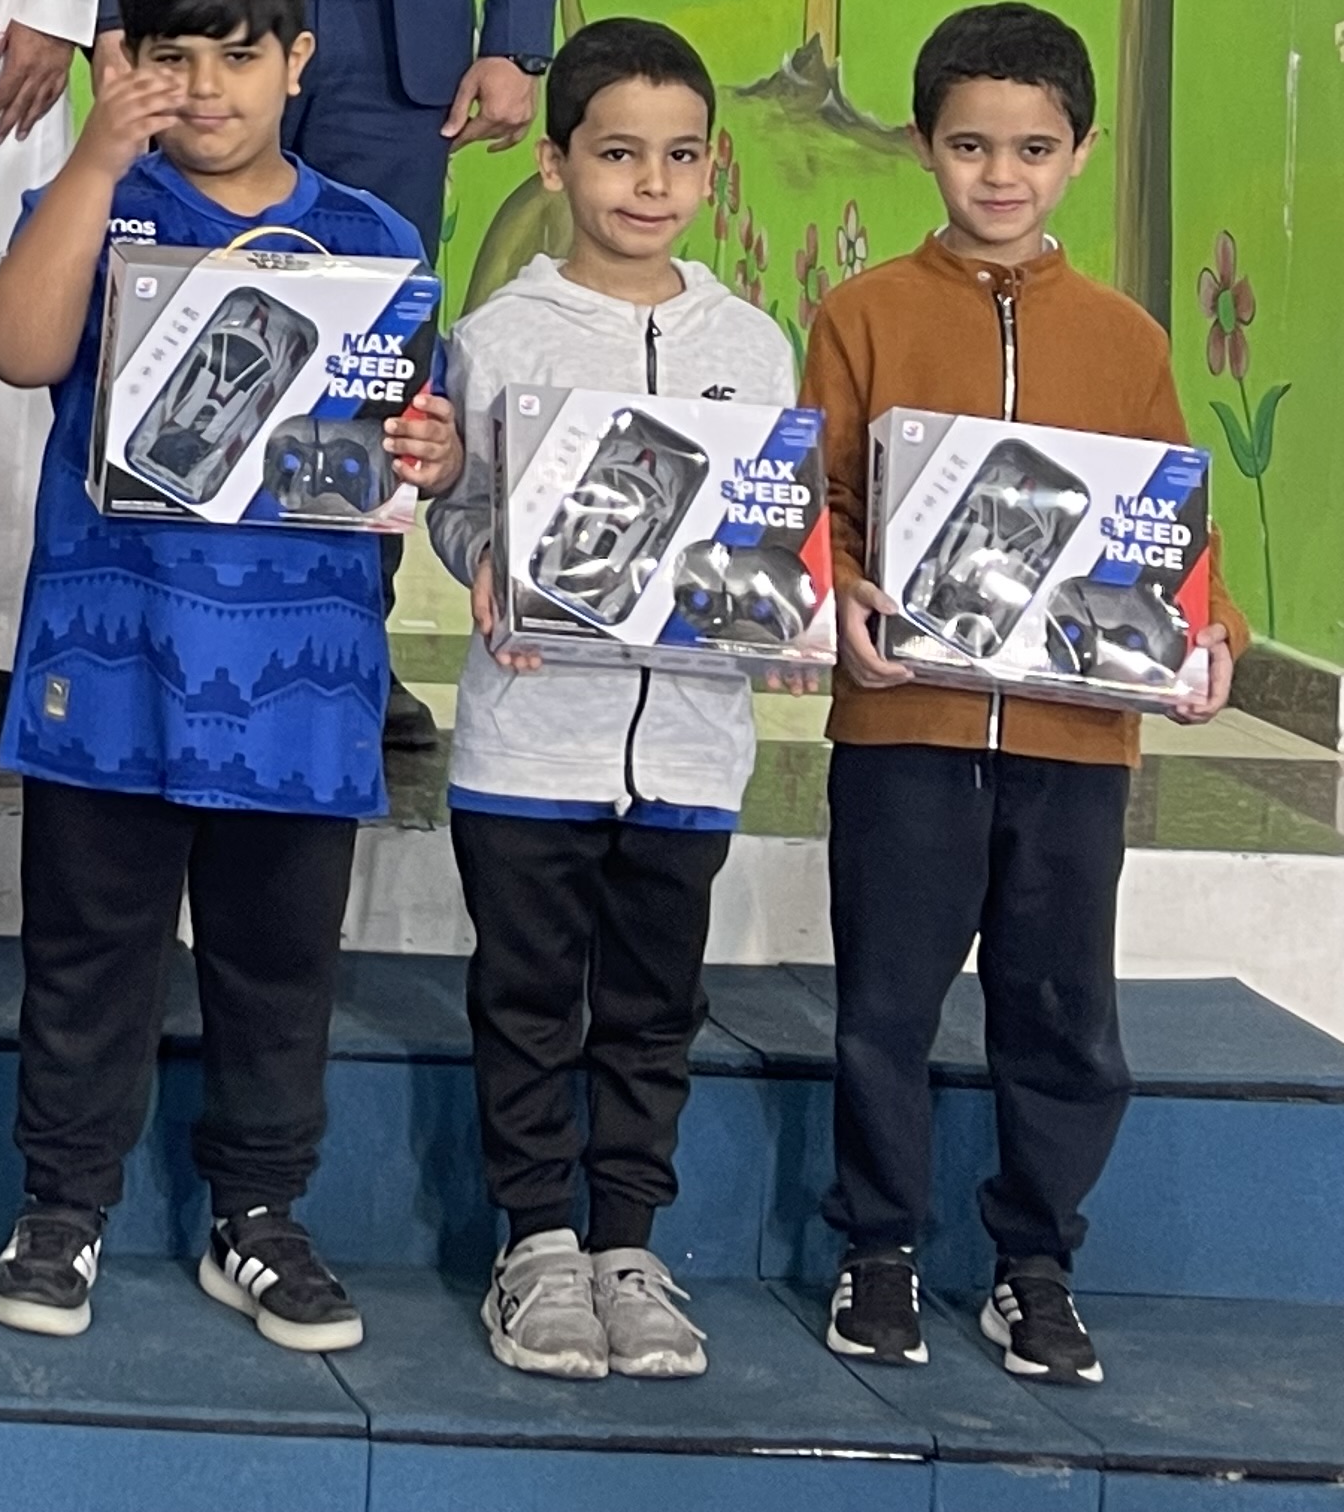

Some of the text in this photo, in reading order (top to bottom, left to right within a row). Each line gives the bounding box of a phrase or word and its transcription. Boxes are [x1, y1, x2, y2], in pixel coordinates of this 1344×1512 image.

[342, 331, 403, 356] MAX
[325, 355, 415, 380] SPEED
[327, 378, 405, 403] RACE
[734, 457, 795, 482] MAX
[721, 480, 811, 507] SPEED
[726, 503, 805, 530] RACE
[1115, 494, 1177, 521] MAX
[1100, 516, 1192, 548] SPEED
[1105, 542, 1184, 570] RACE
